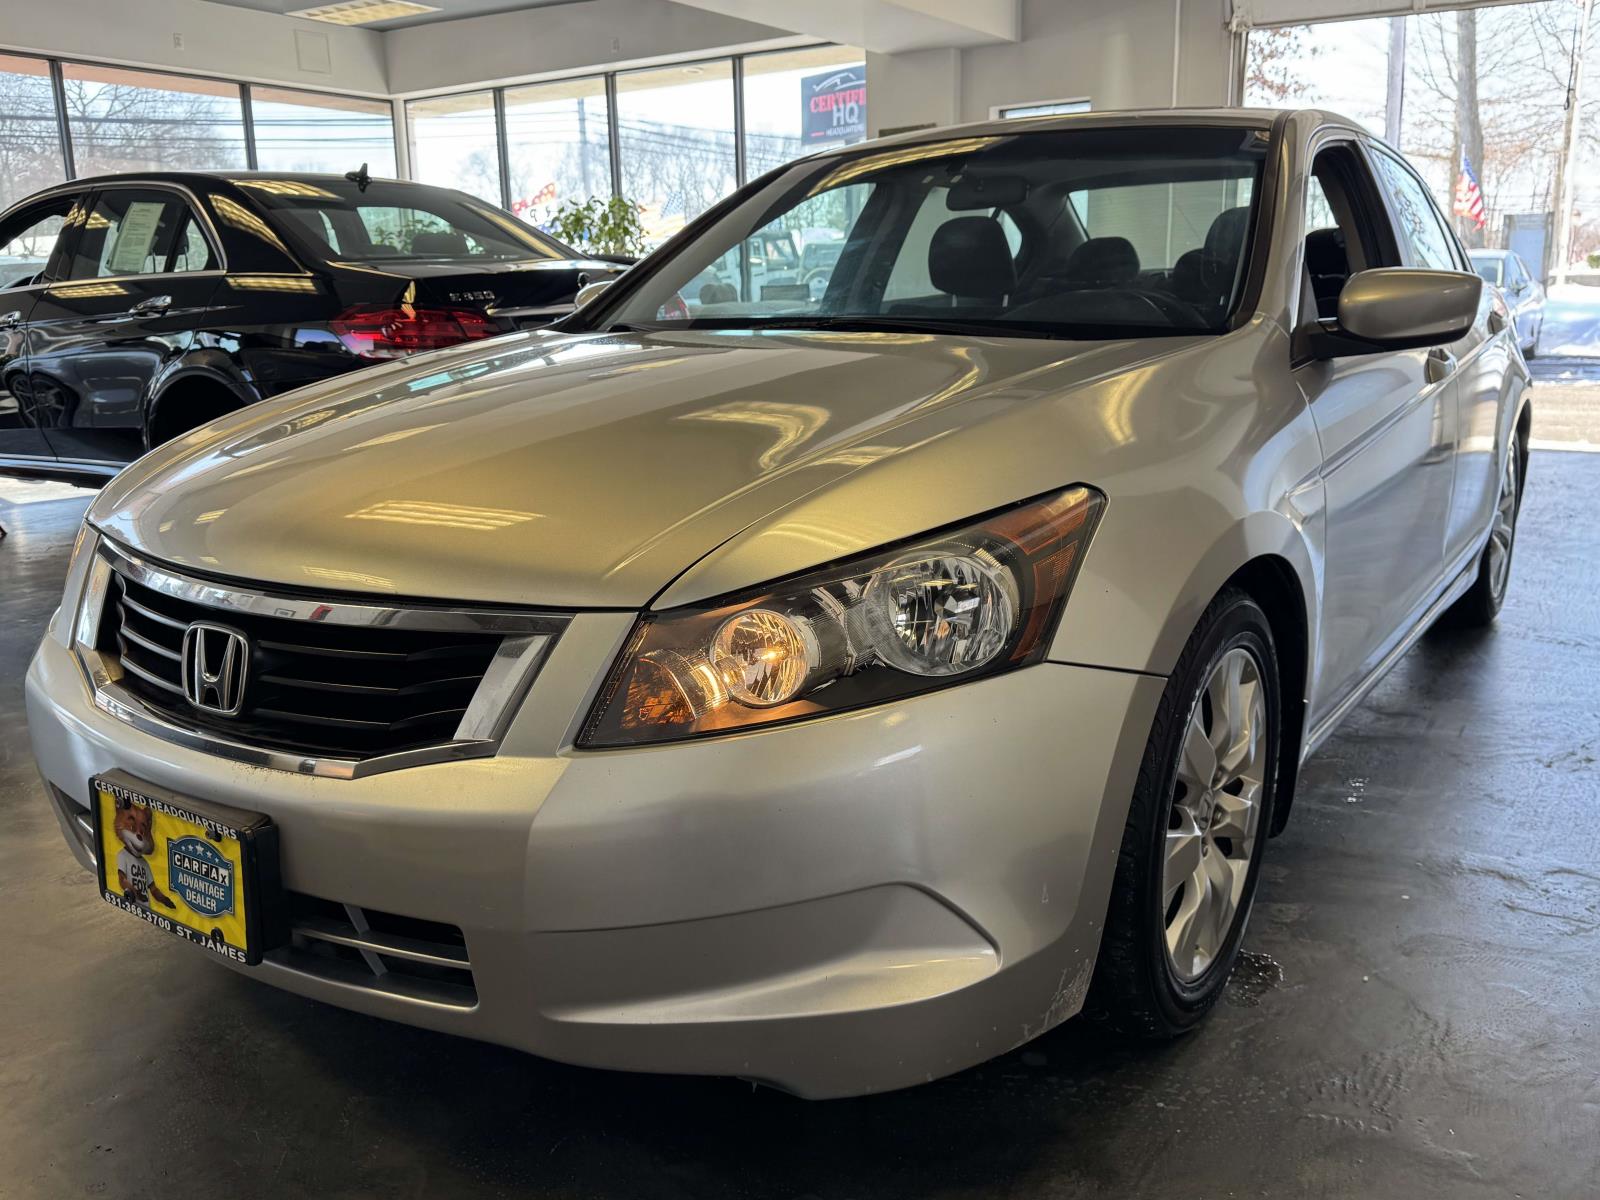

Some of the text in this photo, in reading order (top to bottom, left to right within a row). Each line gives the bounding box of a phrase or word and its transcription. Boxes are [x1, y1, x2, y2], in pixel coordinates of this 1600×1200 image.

[832, 101, 859, 127] HQ
[94, 780, 237, 839] CERTIFIED HEADQUARTERS
[131, 864, 146, 880] CAR
[174, 854, 228, 886] CARFAX
[132, 878, 147, 894] FOX
[178, 872, 225, 901] ADVANTAGE
[186, 890, 217, 912] DEALER
[176, 925, 197, 943] ST.
[200, 936, 247, 963] JAMES
